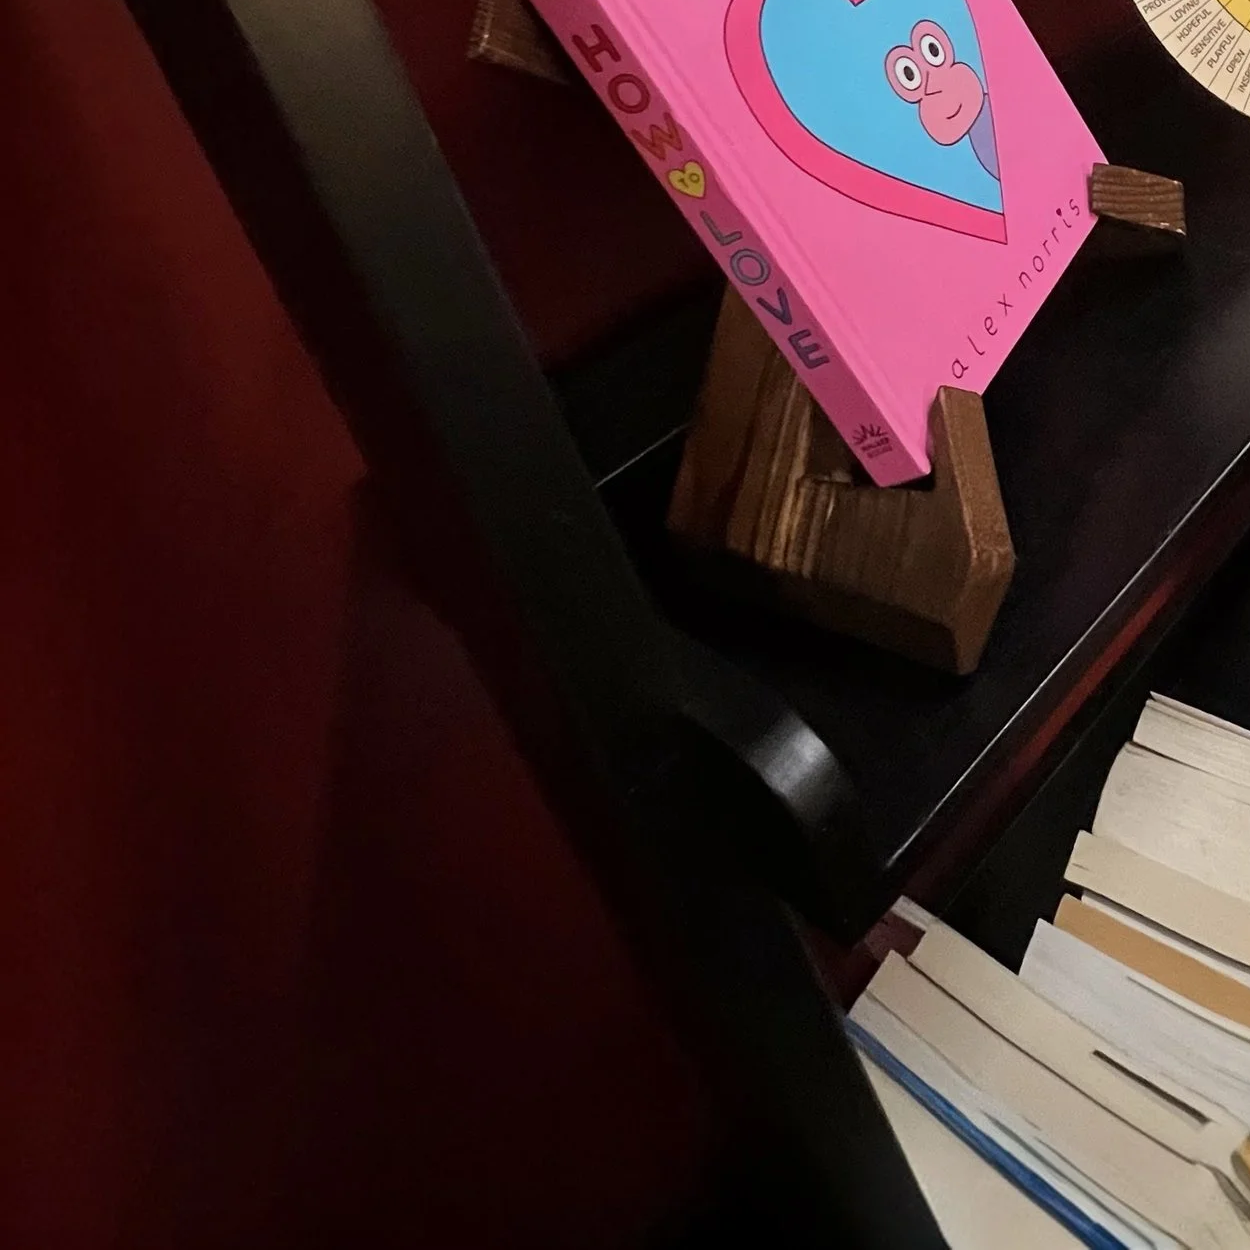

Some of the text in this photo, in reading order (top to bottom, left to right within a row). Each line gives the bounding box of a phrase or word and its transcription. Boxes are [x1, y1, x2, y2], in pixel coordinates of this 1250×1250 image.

[1176, 8, 1212, 42] HOPEFUL
[1190, 18, 1227, 58] SENSITIVE
[1207, 33, 1235, 69] PLAYFUL
[1226, 49, 1245, 74] OPEN
[572, 24, 830, 370] HOW TO LOVE
[952, 199, 1080, 379] alex norris
